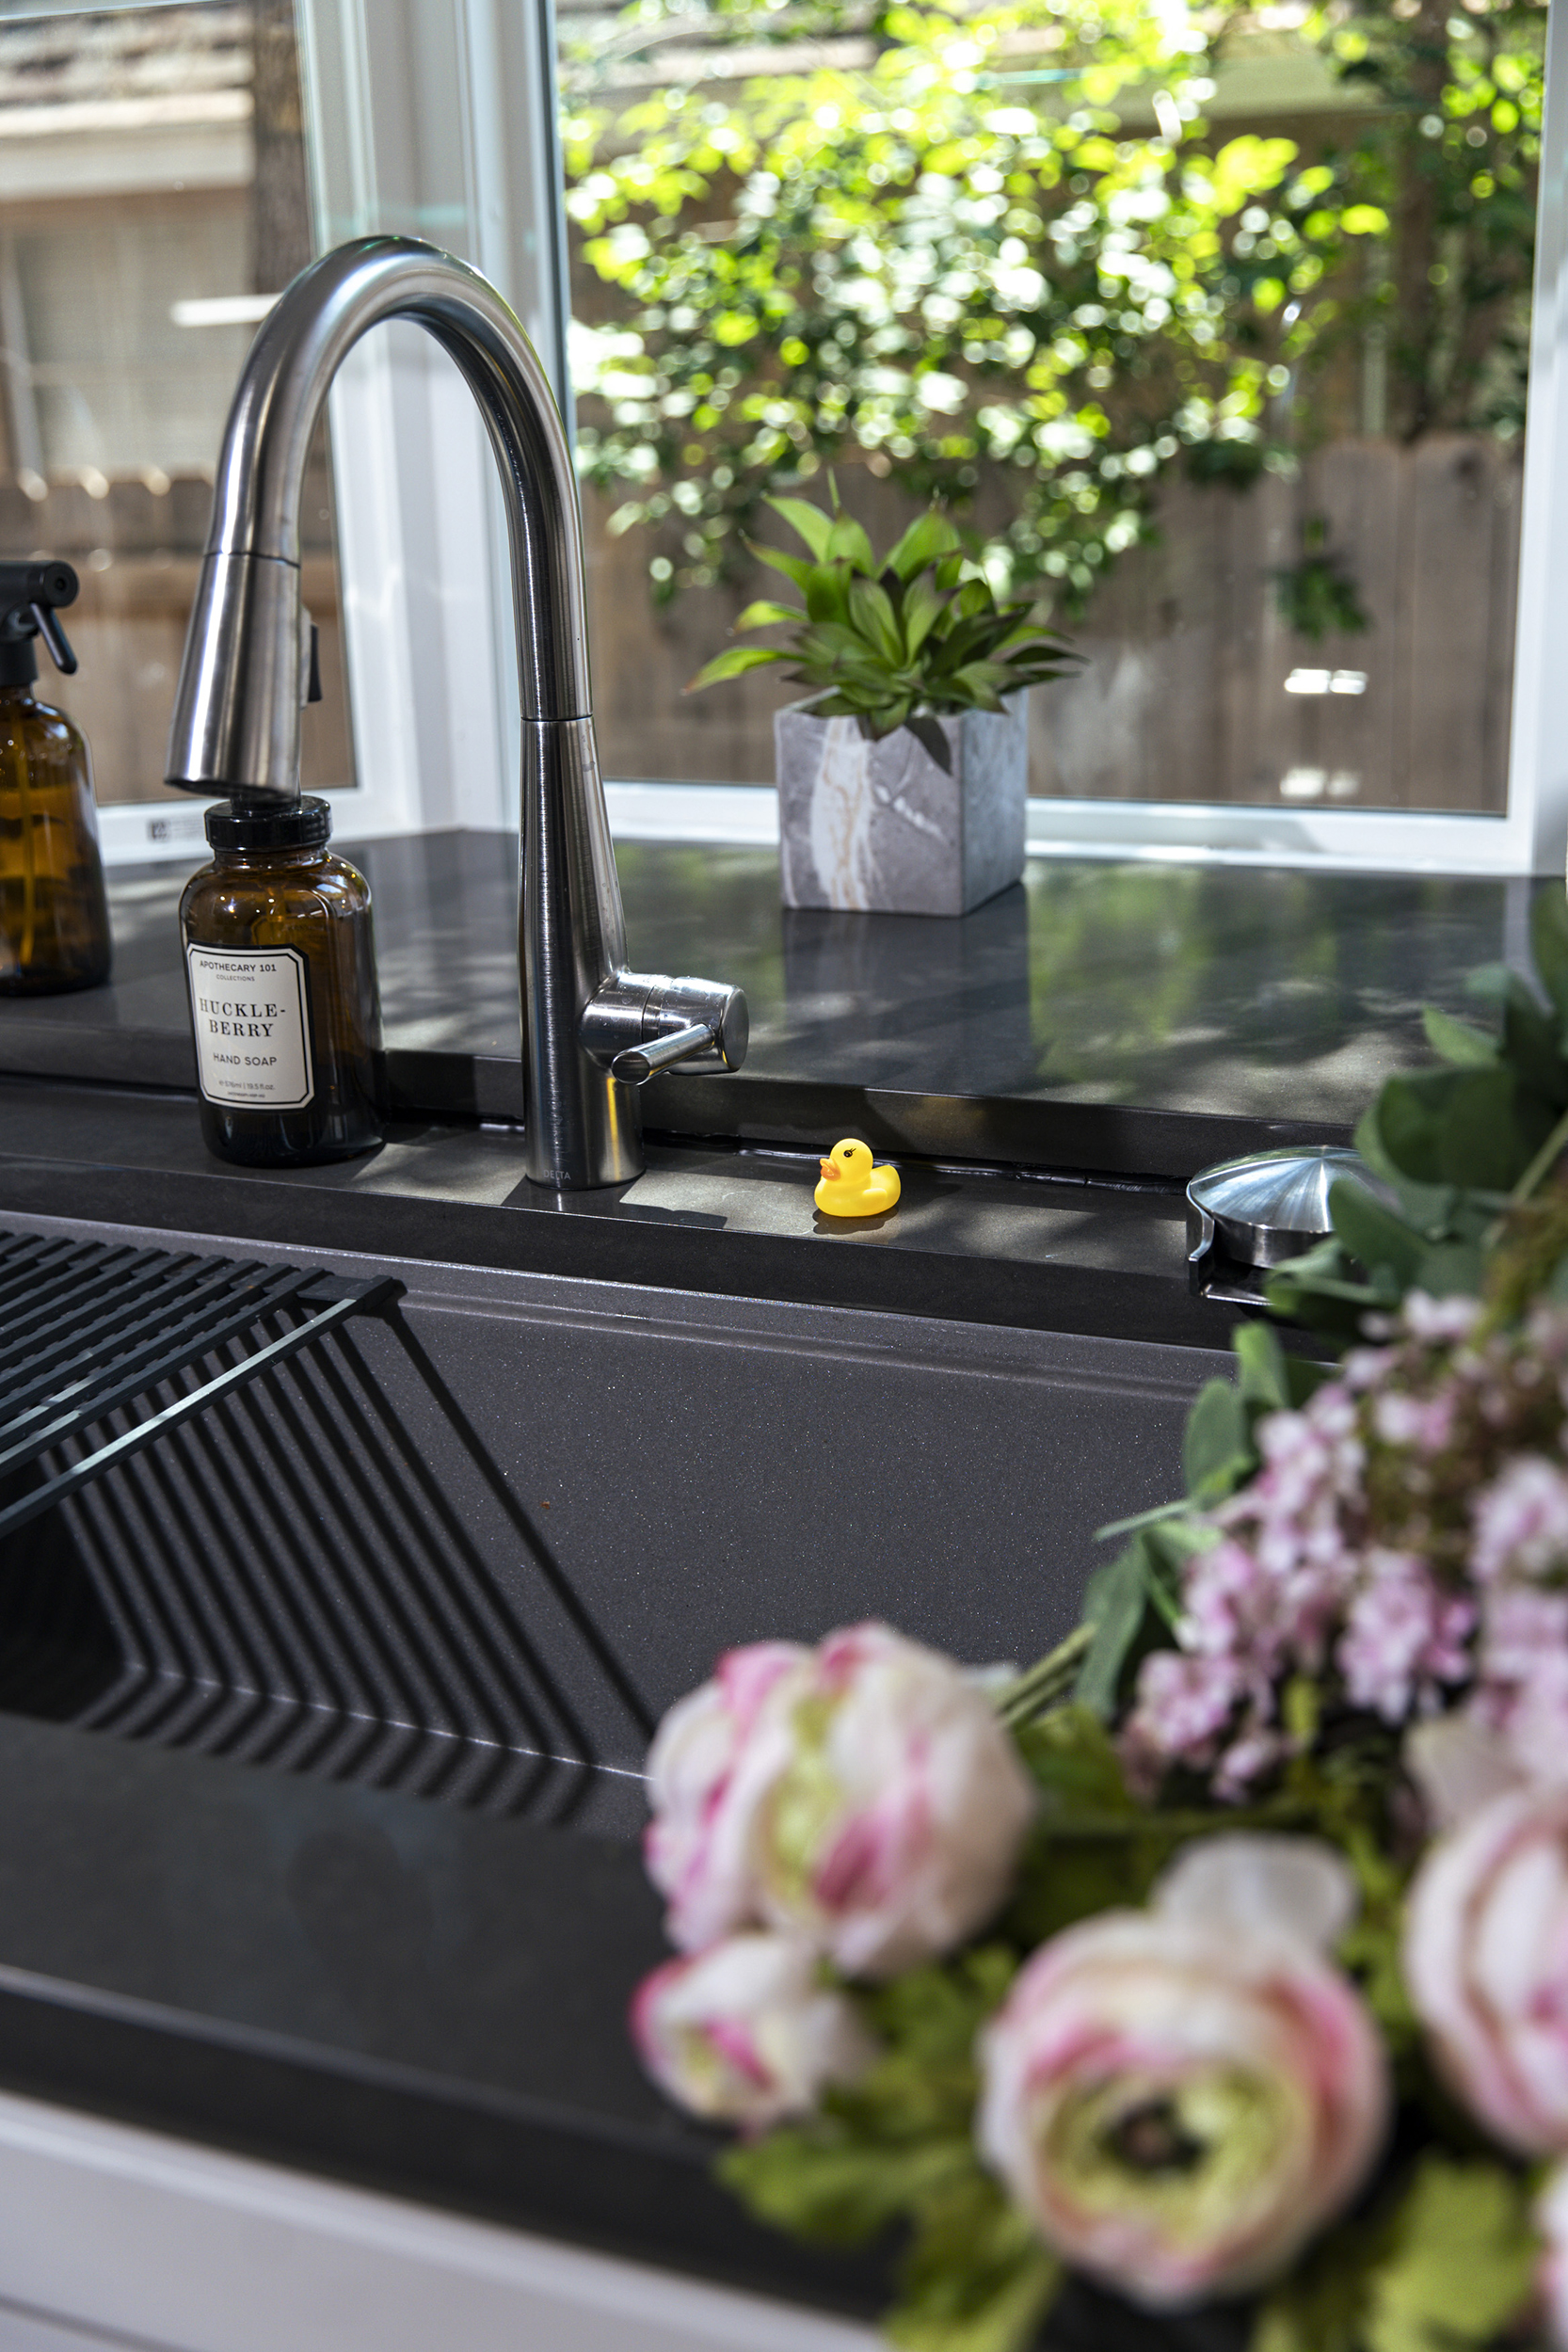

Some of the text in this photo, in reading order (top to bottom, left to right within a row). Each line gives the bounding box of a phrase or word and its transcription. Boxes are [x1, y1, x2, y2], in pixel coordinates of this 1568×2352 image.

[200, 960, 277, 971] APOTHECARY 101
[216, 973, 255, 982] COLLECTIONS
[199, 998, 286, 1017] HUCKLE-
[209, 1018, 274, 1037] BERRY
[214, 1052, 277, 1066] HAND SOAP
[543, 1169, 571, 1180] DELTA
